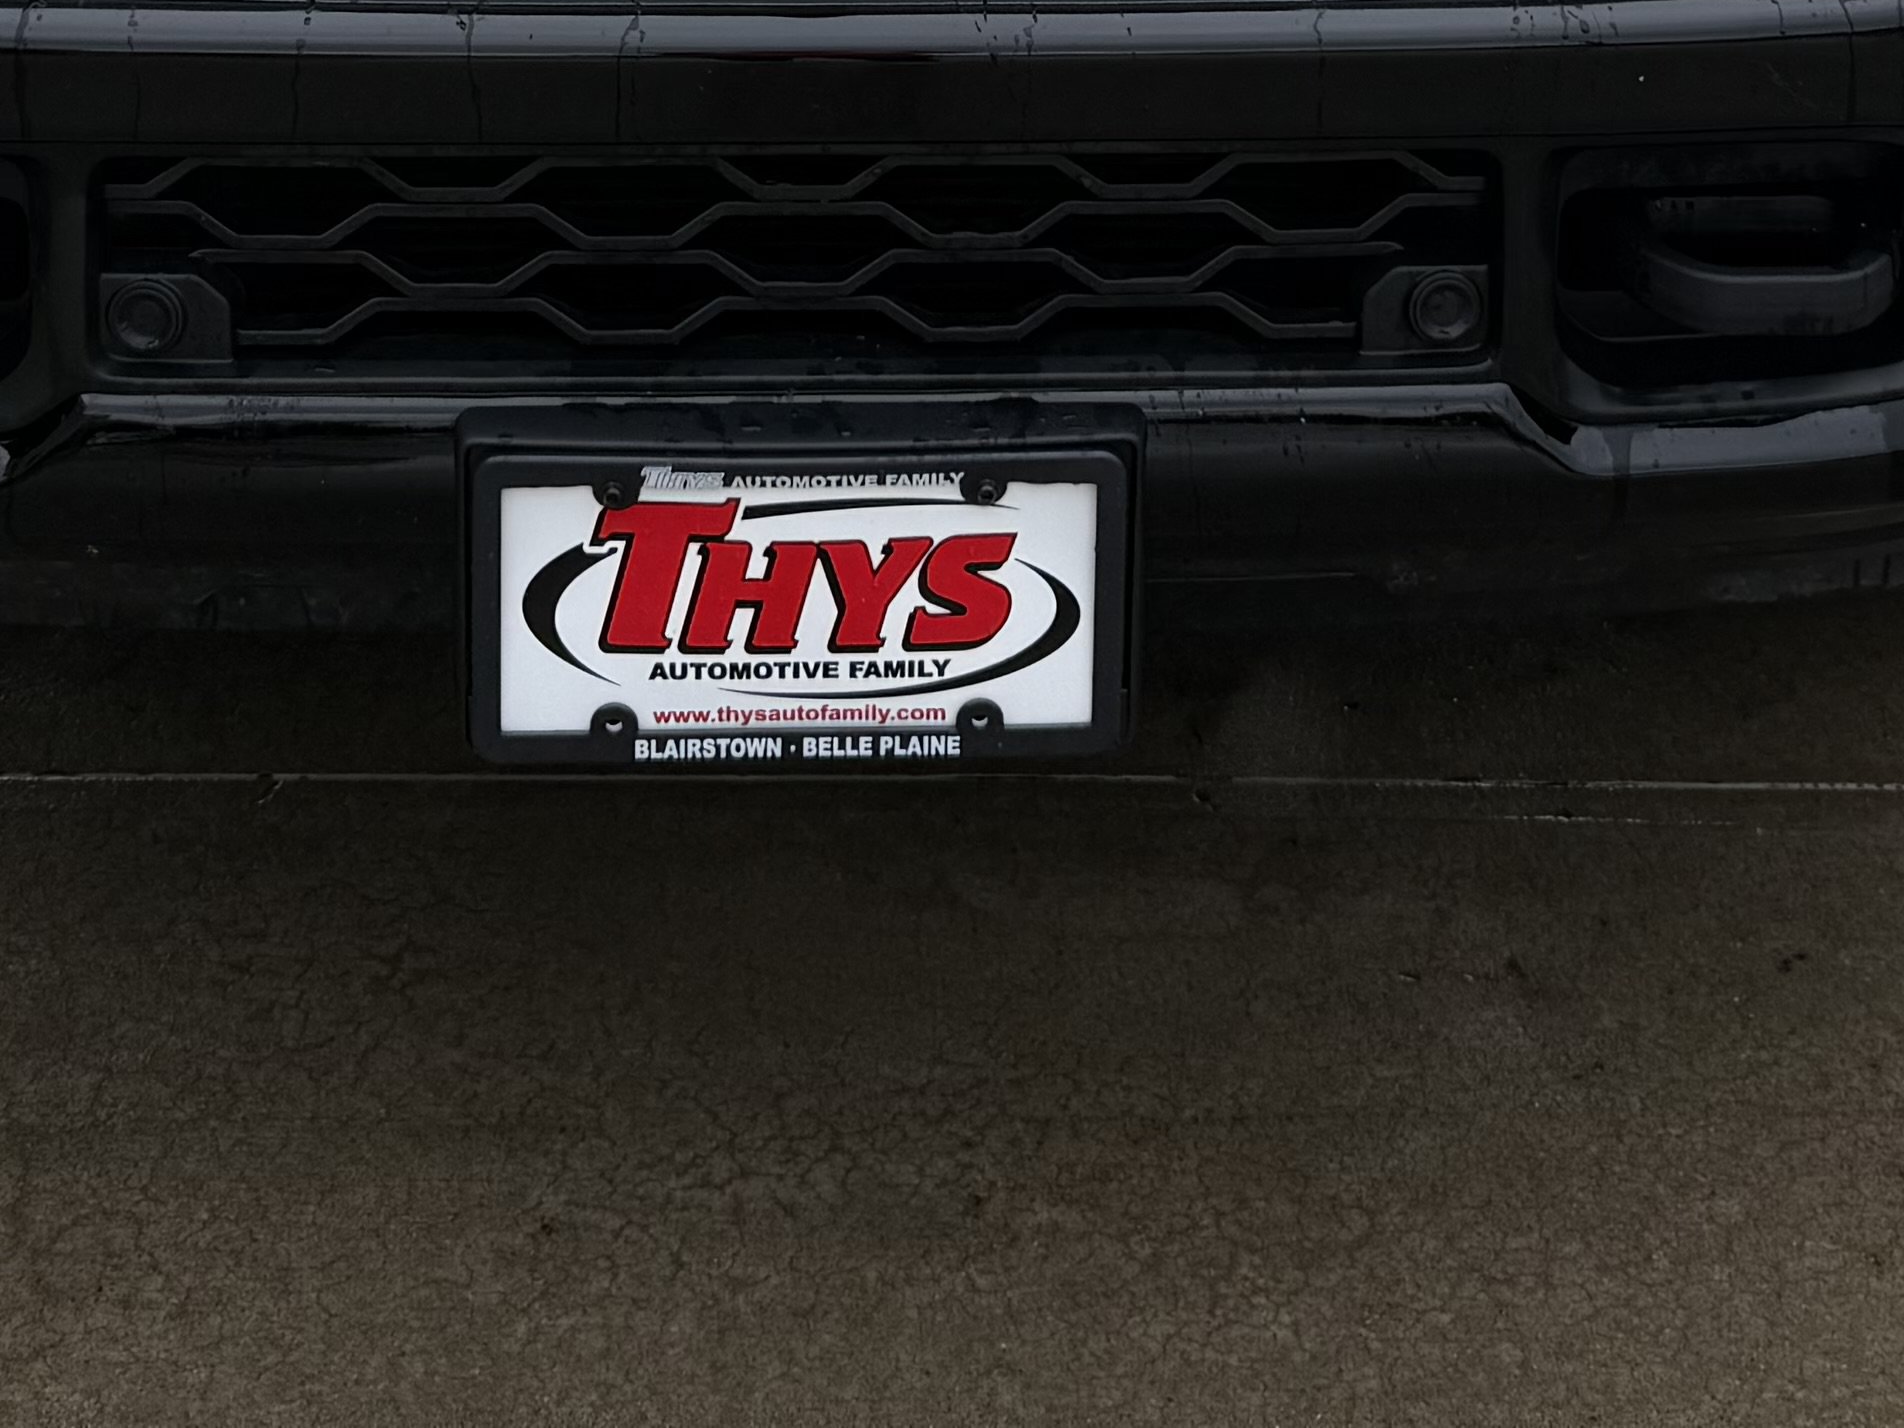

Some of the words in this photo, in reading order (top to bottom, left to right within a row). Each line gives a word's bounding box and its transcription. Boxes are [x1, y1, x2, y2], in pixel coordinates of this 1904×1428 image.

[730, 475, 878, 489] AUTOMOTIVE
[885, 472, 965, 488] FAMILY
[592, 497, 1018, 655] THYS
[648, 661, 839, 680] AUTOMOTIVE
[849, 659, 951, 678] FAMILY
[653, 704, 947, 724] www.thysautofamily.com
[634, 738, 782, 760] BLAIRSTOWN
[802, 737, 873, 758] BELLE
[879, 735, 961, 757] PLAINE
